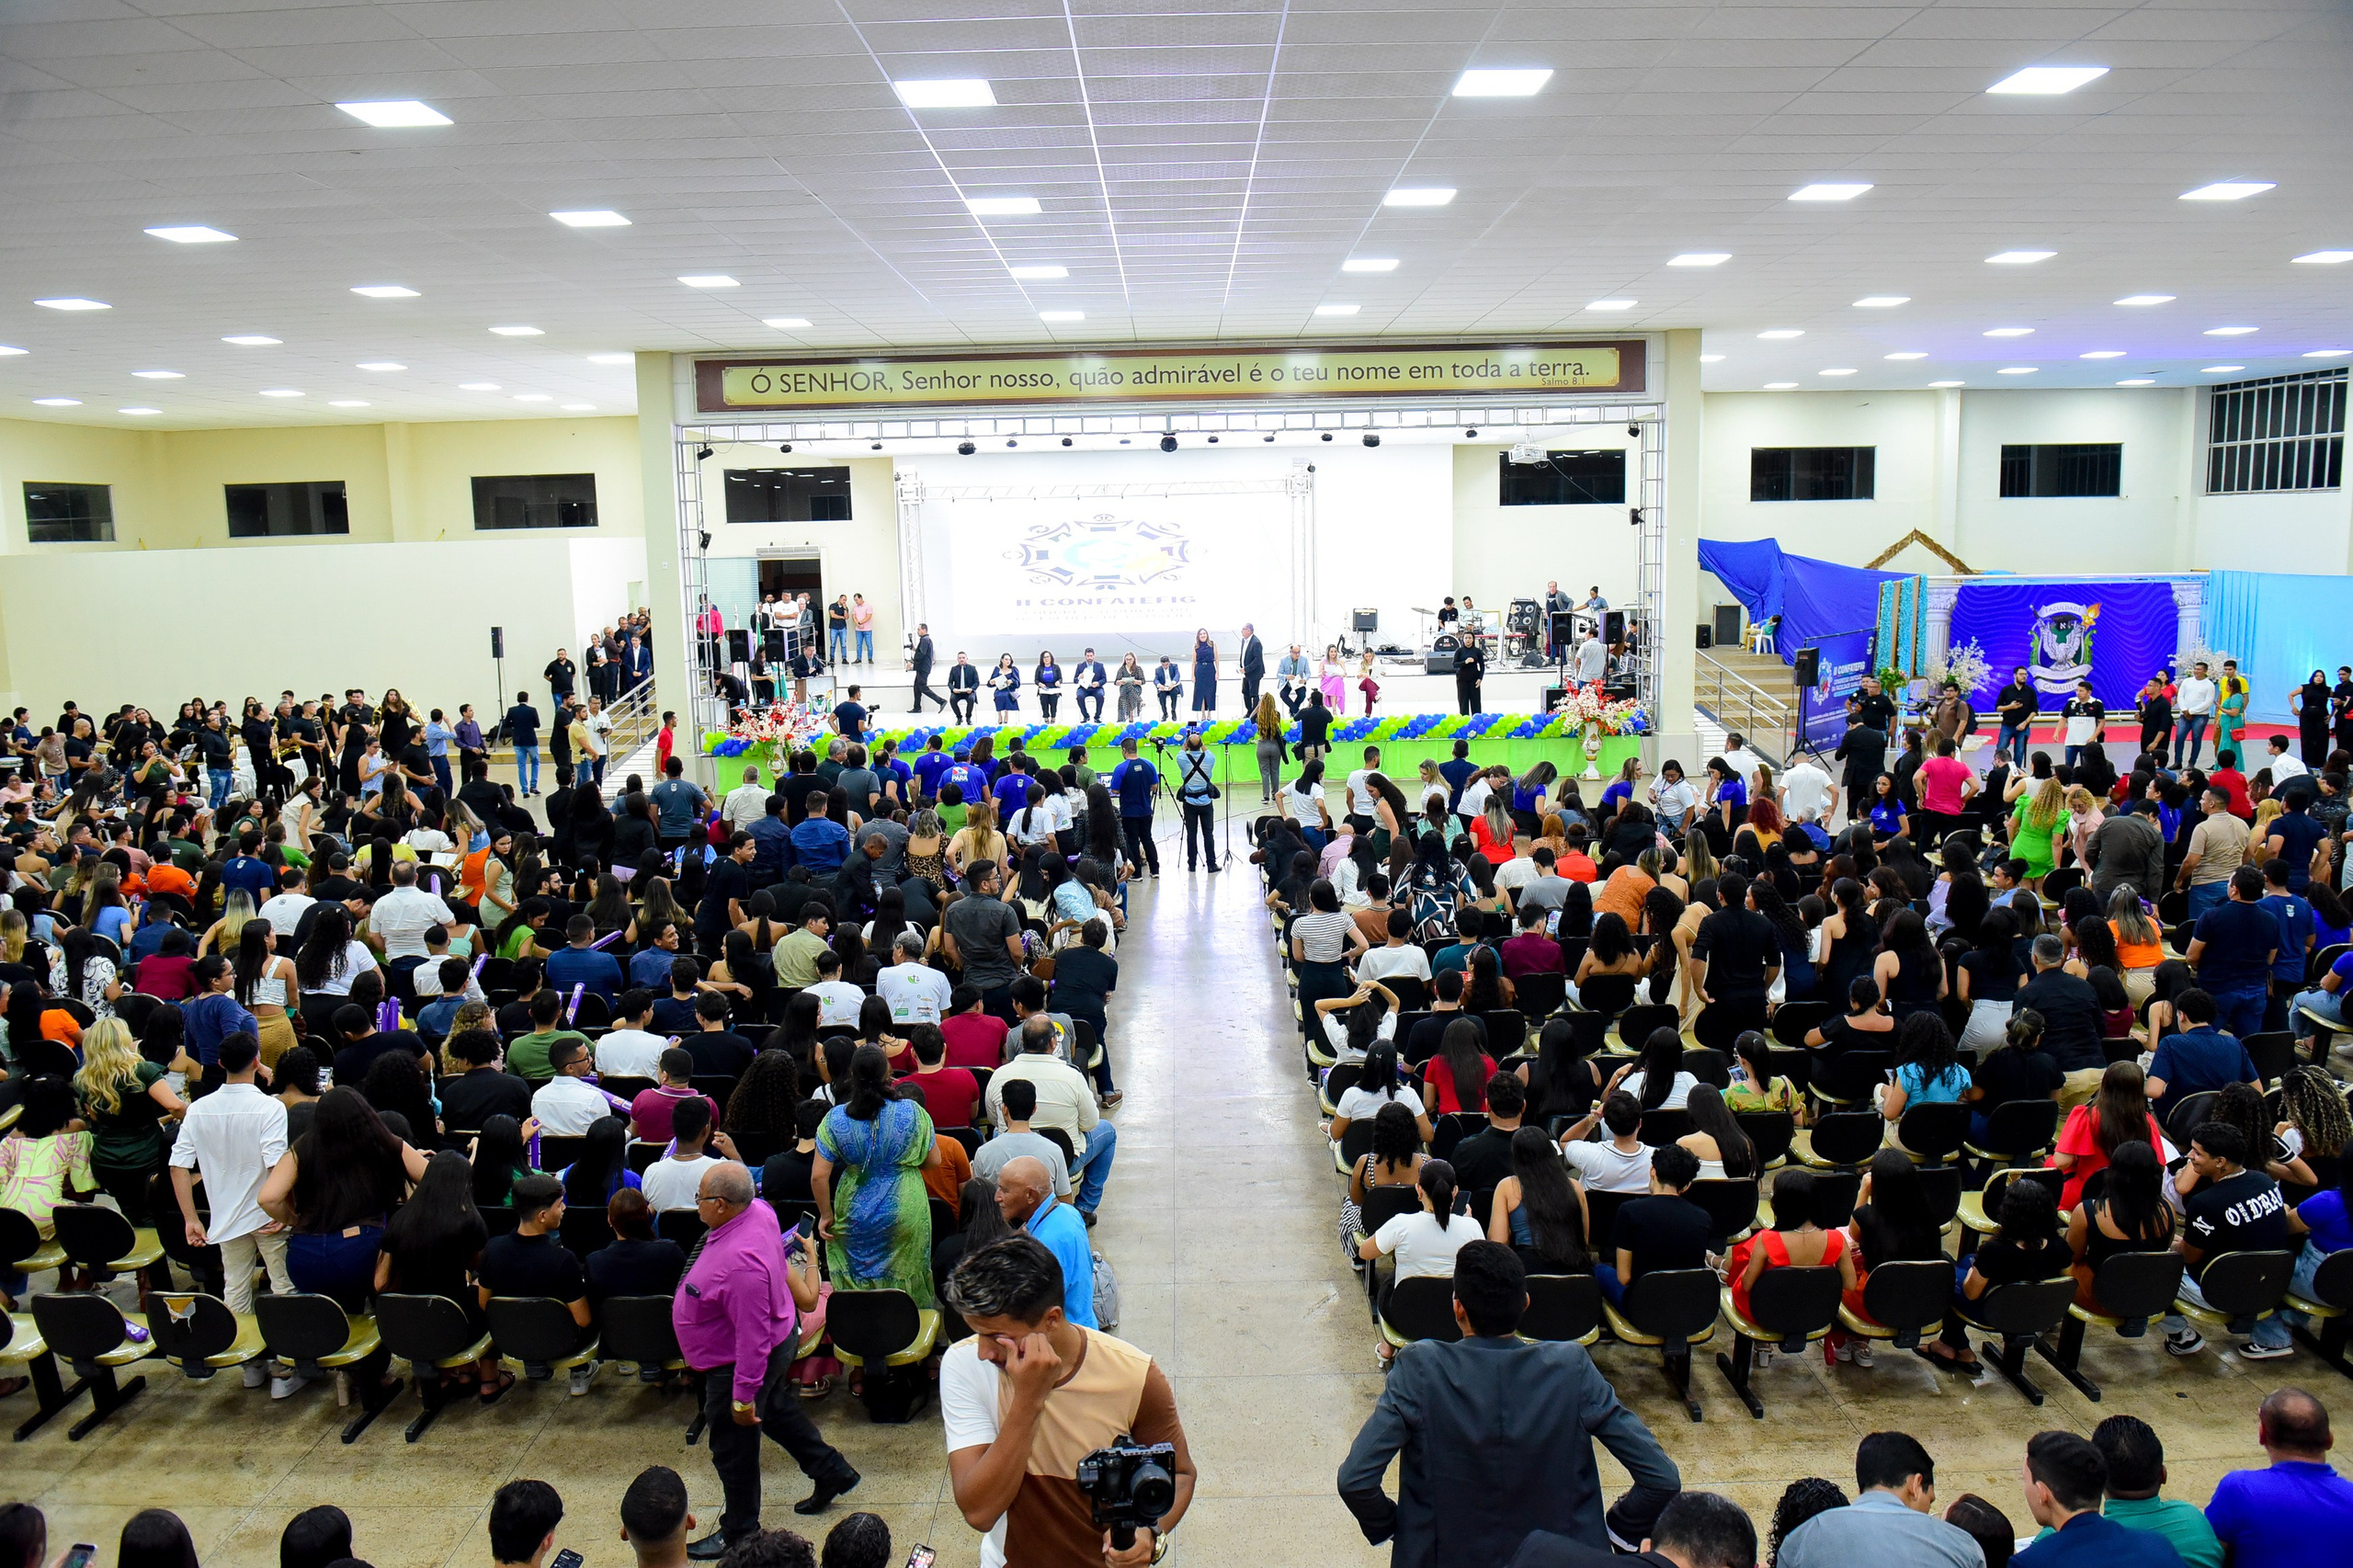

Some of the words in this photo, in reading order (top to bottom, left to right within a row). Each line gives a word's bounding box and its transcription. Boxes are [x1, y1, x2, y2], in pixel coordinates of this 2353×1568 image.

[751, 369, 771, 393] Ó
[779, 370, 893, 393] SENHOR,
[902, 369, 982, 390] Senhor
[990, 372, 1061, 390] nosso,
[1069, 368, 1124, 392] quão
[1131, 364, 1241, 384] admirável
[1249, 362, 1263, 381] é
[1270, 370, 1284, 381] o
[1292, 366, 1327, 381] teu
[1337, 365, 1401, 380] nome
[1408, 364, 1443, 379] em
[1451, 358, 1500, 378] toda
[1509, 365, 1521, 377] a
[1529, 360, 1590, 377] terra.
[1541, 377, 1569, 386] Salmo
[1040, 596, 1196, 607] CONFATEFIG
[2045, 604, 2081, 613] FACULDADE
[2043, 684, 2075, 692] GAMALIEL
